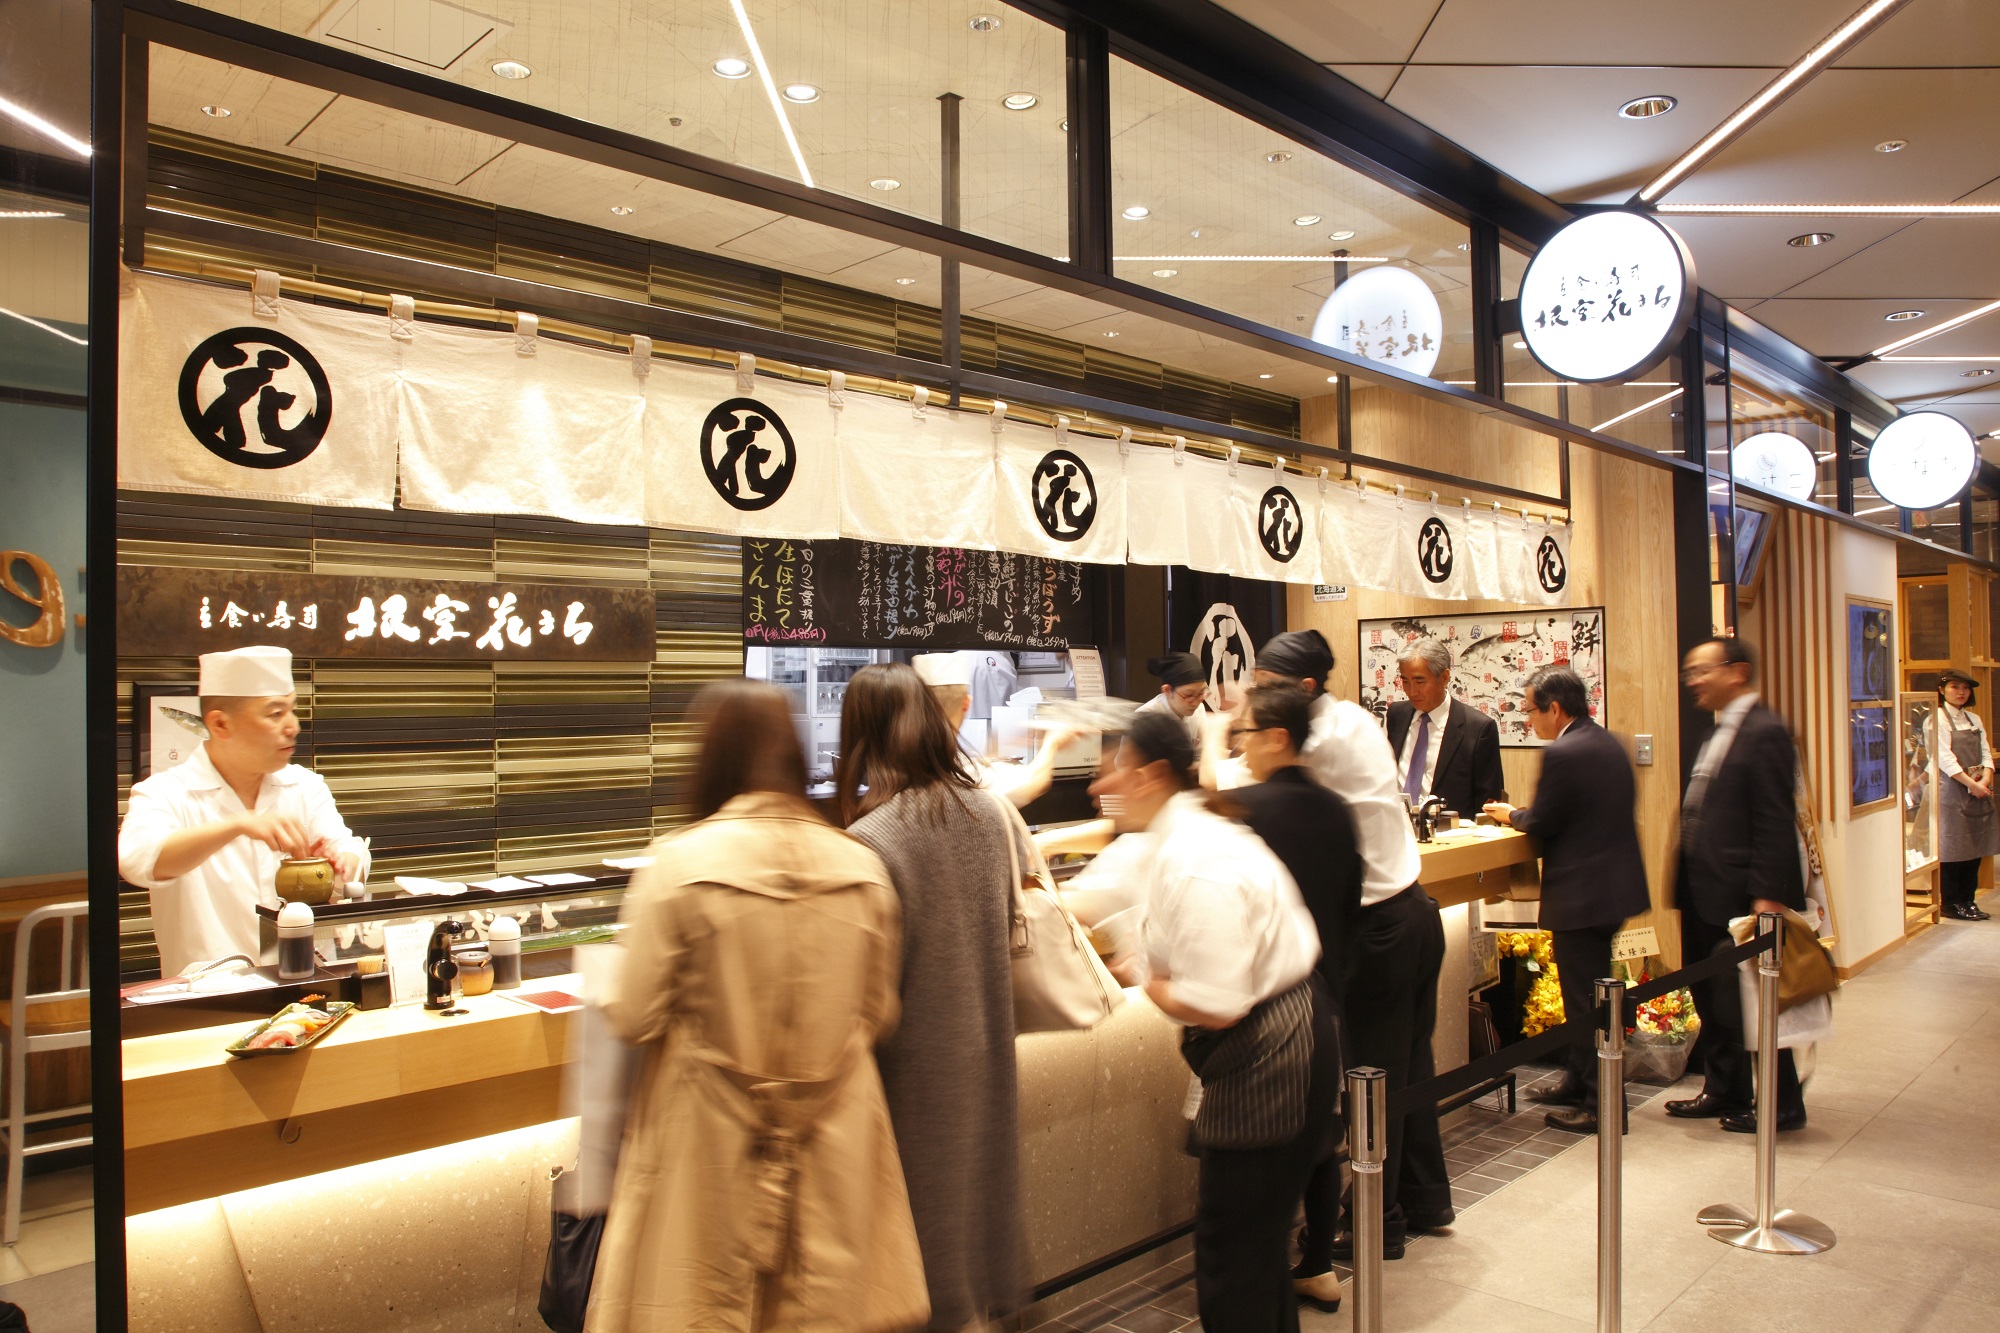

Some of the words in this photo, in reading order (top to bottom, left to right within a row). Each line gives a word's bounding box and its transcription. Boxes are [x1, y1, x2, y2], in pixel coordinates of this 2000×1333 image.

[344, 592, 593, 651] 根室花まる
[748, 541, 770, 622] さんま
[774, 541, 796, 629] 生ほたて
